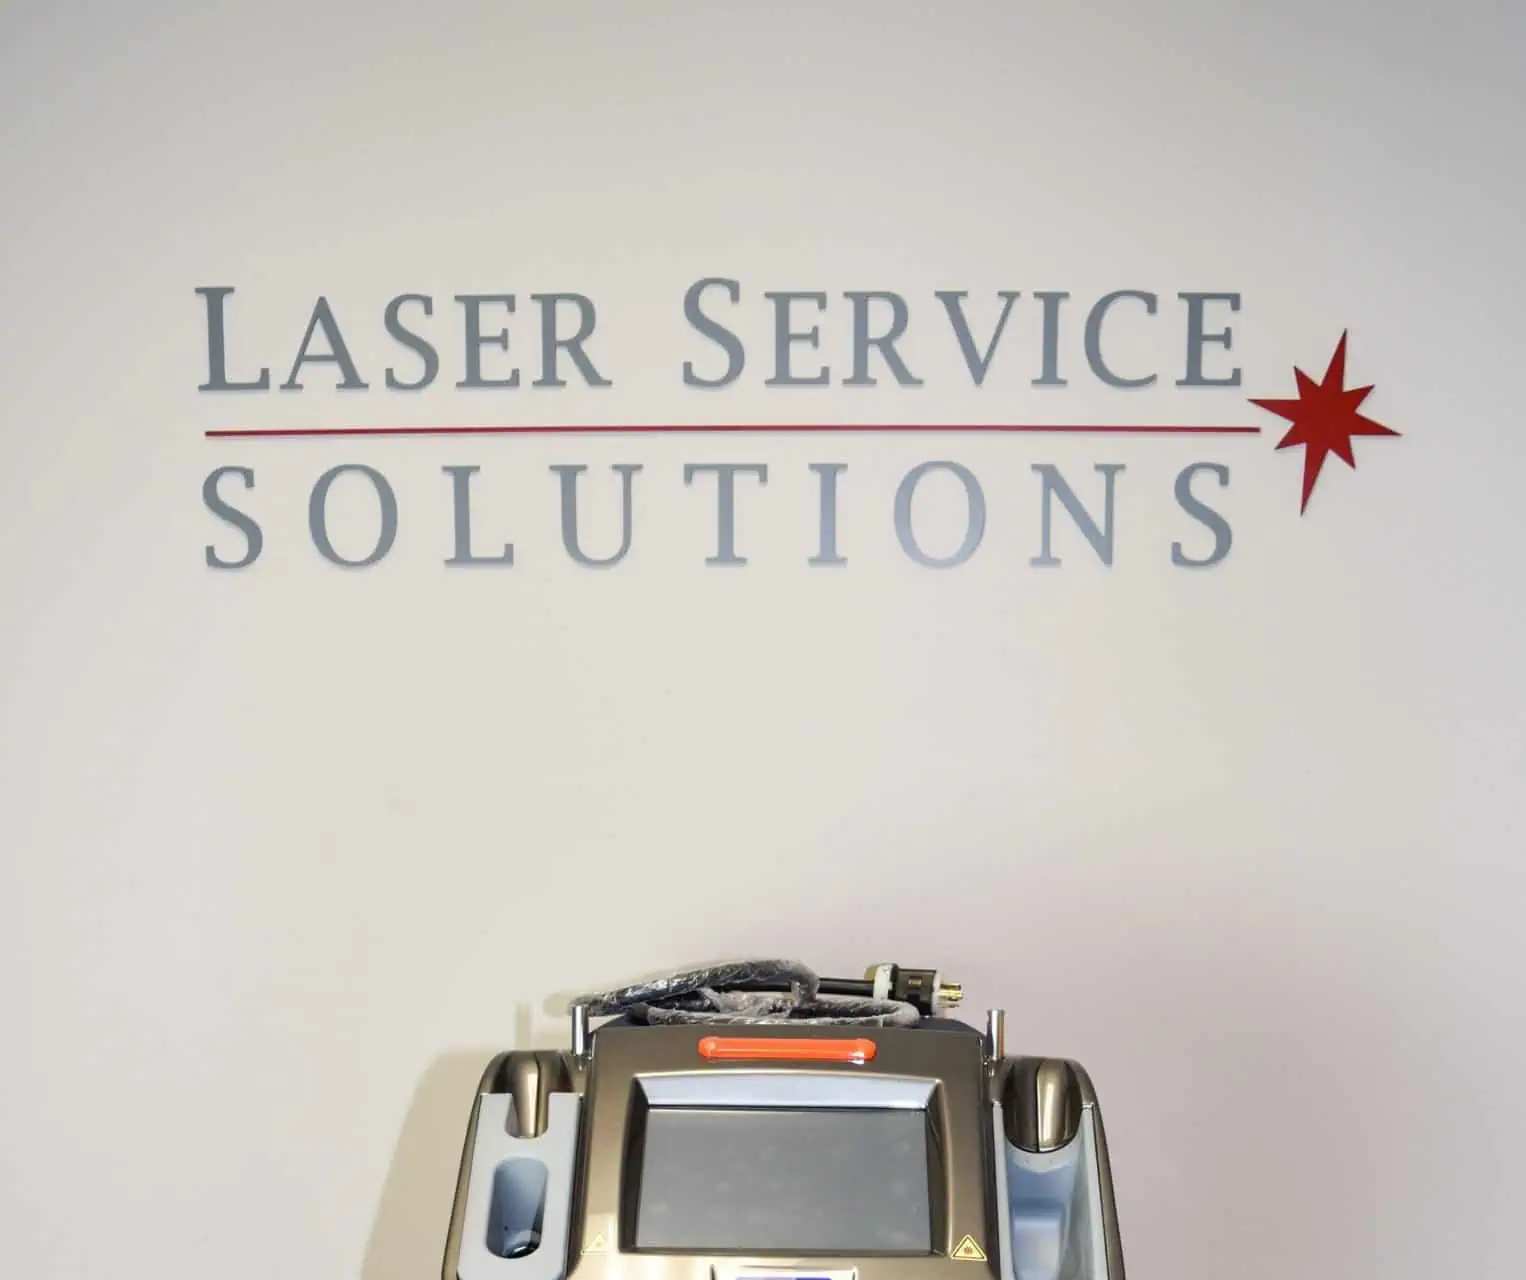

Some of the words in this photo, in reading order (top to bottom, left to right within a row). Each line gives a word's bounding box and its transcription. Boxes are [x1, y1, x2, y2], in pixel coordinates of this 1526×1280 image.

[195, 286, 612, 392] LASER
[682, 277, 1243, 390] SERVICE
[202, 461, 1234, 571] SOLUTIONS
